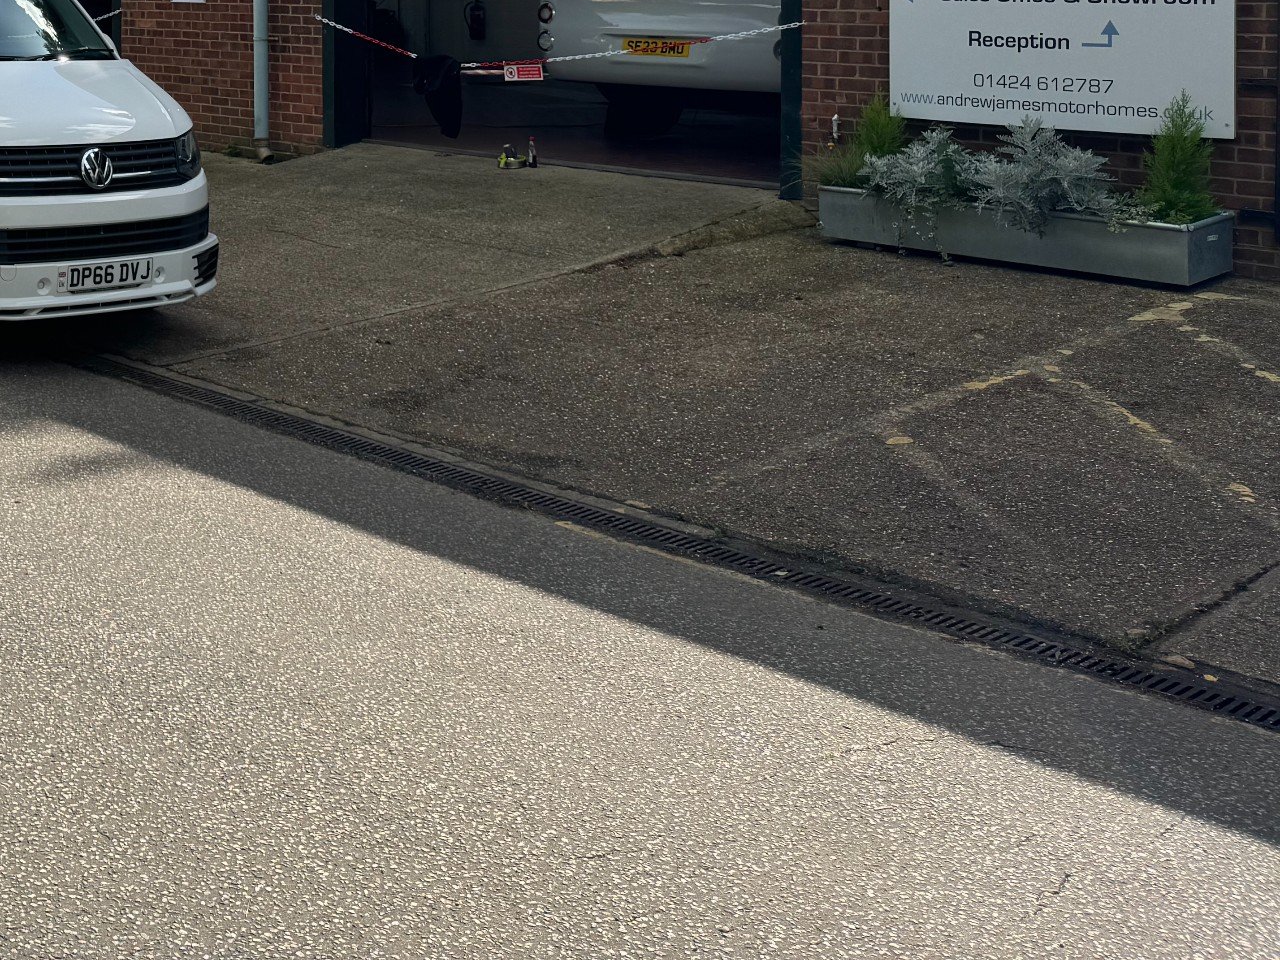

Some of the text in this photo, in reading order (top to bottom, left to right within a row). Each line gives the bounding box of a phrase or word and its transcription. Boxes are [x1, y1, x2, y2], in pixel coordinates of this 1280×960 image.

[968, 30, 1071, 52] Reception
[973, 73, 1114, 93] 01424 612787
[900, 91, 1215, 121] www.andrewjamesmotorhomes.cuk
[69, 260, 151, 288] DP66 DVJ
